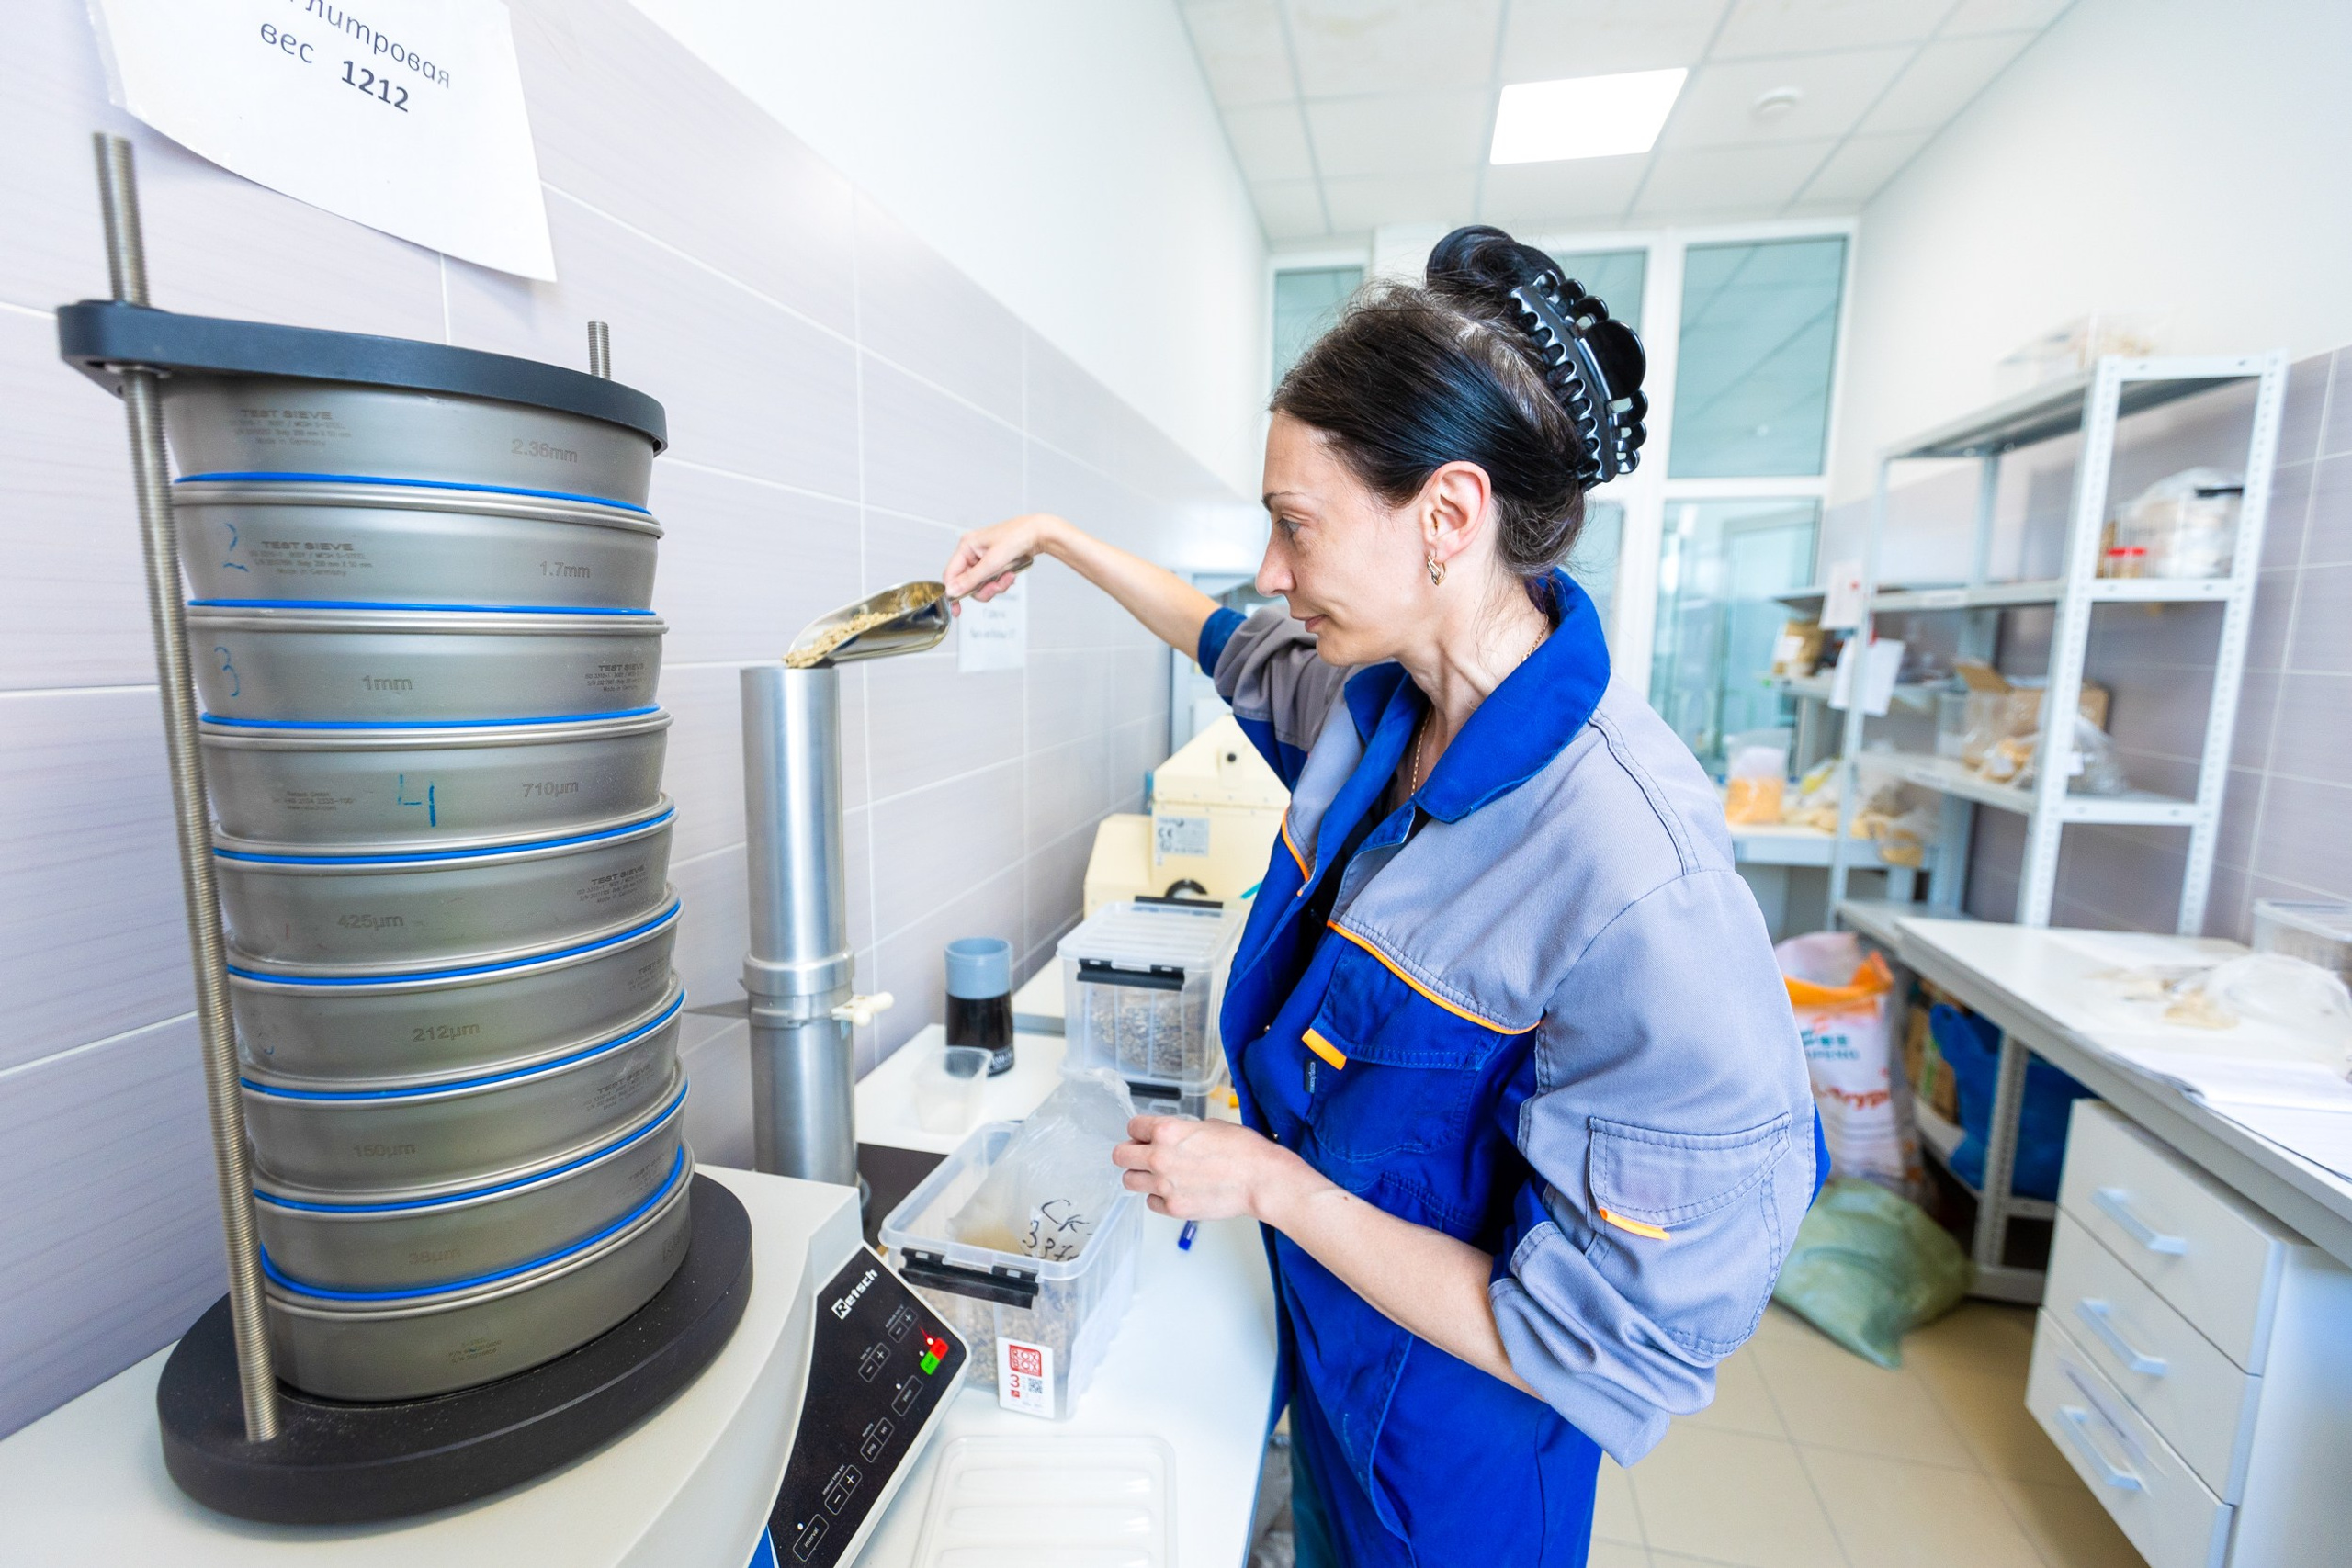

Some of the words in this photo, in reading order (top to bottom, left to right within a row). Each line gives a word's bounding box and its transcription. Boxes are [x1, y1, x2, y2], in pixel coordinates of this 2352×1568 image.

[260, 23, 315, 64] вес
[305, 0, 450, 89] литровая
[341, 60, 409, 113] 1212
[240, 409, 278, 419] TEST
[282, 410, 333, 421] SIEVE
[511, 438, 578, 463] 2.36mm
[261, 540, 300, 550] TEST
[304, 541, 355, 552] SIEVE
[539, 560, 591, 579] 1.7mm
[214, 646, 240, 697] 3
[598, 664, 623, 672] TEST
[362, 674, 413, 691] 1mm
[396, 773, 437, 828] 4
[591, 874, 619, 886] TEST
[831, 1269, 878, 1320] Retsch
[1010, 1373, 1020, 1389] 3
[804, 1526, 820, 1549] interval
